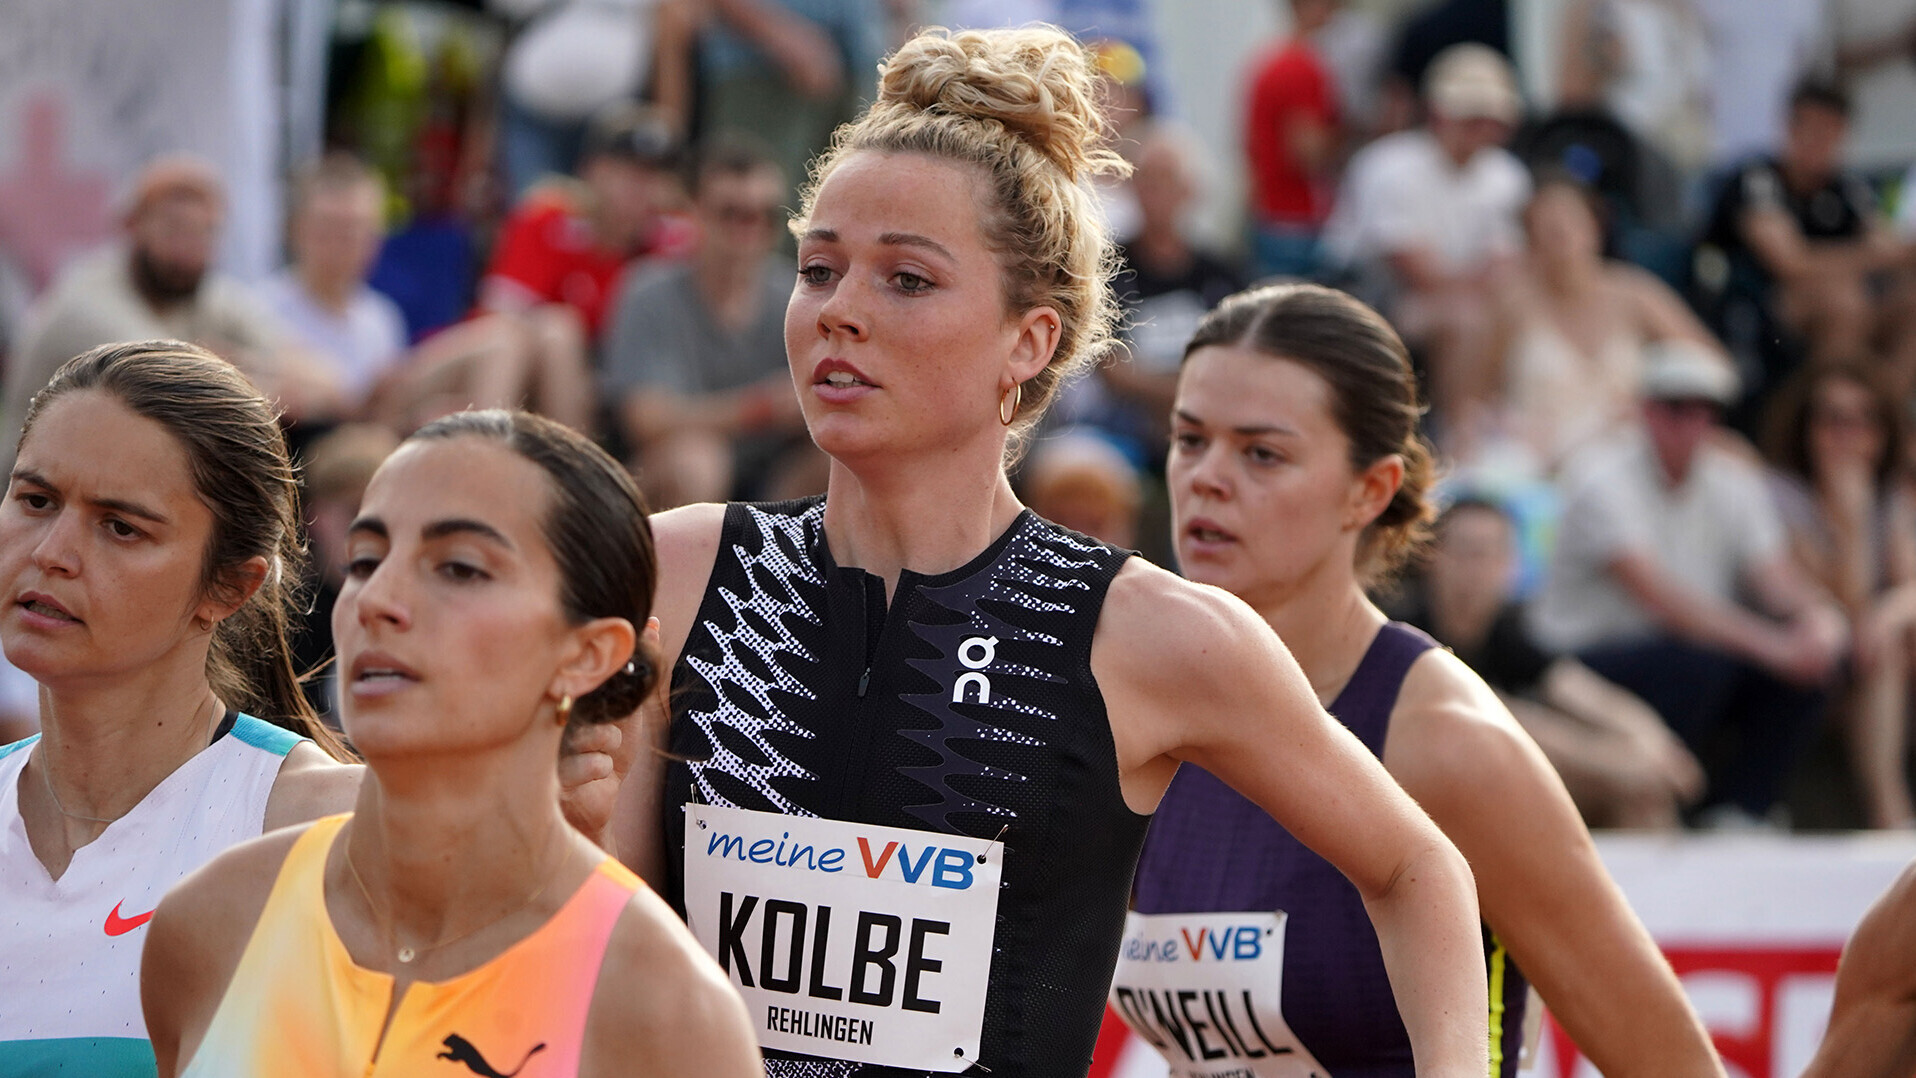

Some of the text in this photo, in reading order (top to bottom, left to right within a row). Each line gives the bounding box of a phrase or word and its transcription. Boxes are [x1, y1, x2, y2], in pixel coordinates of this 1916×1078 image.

[707, 831, 975, 890] meine VVB
[718, 891, 951, 1015] KOLBE
[1181, 926, 1263, 961] VVB
[767, 1006, 874, 1046] REHLINGEN
